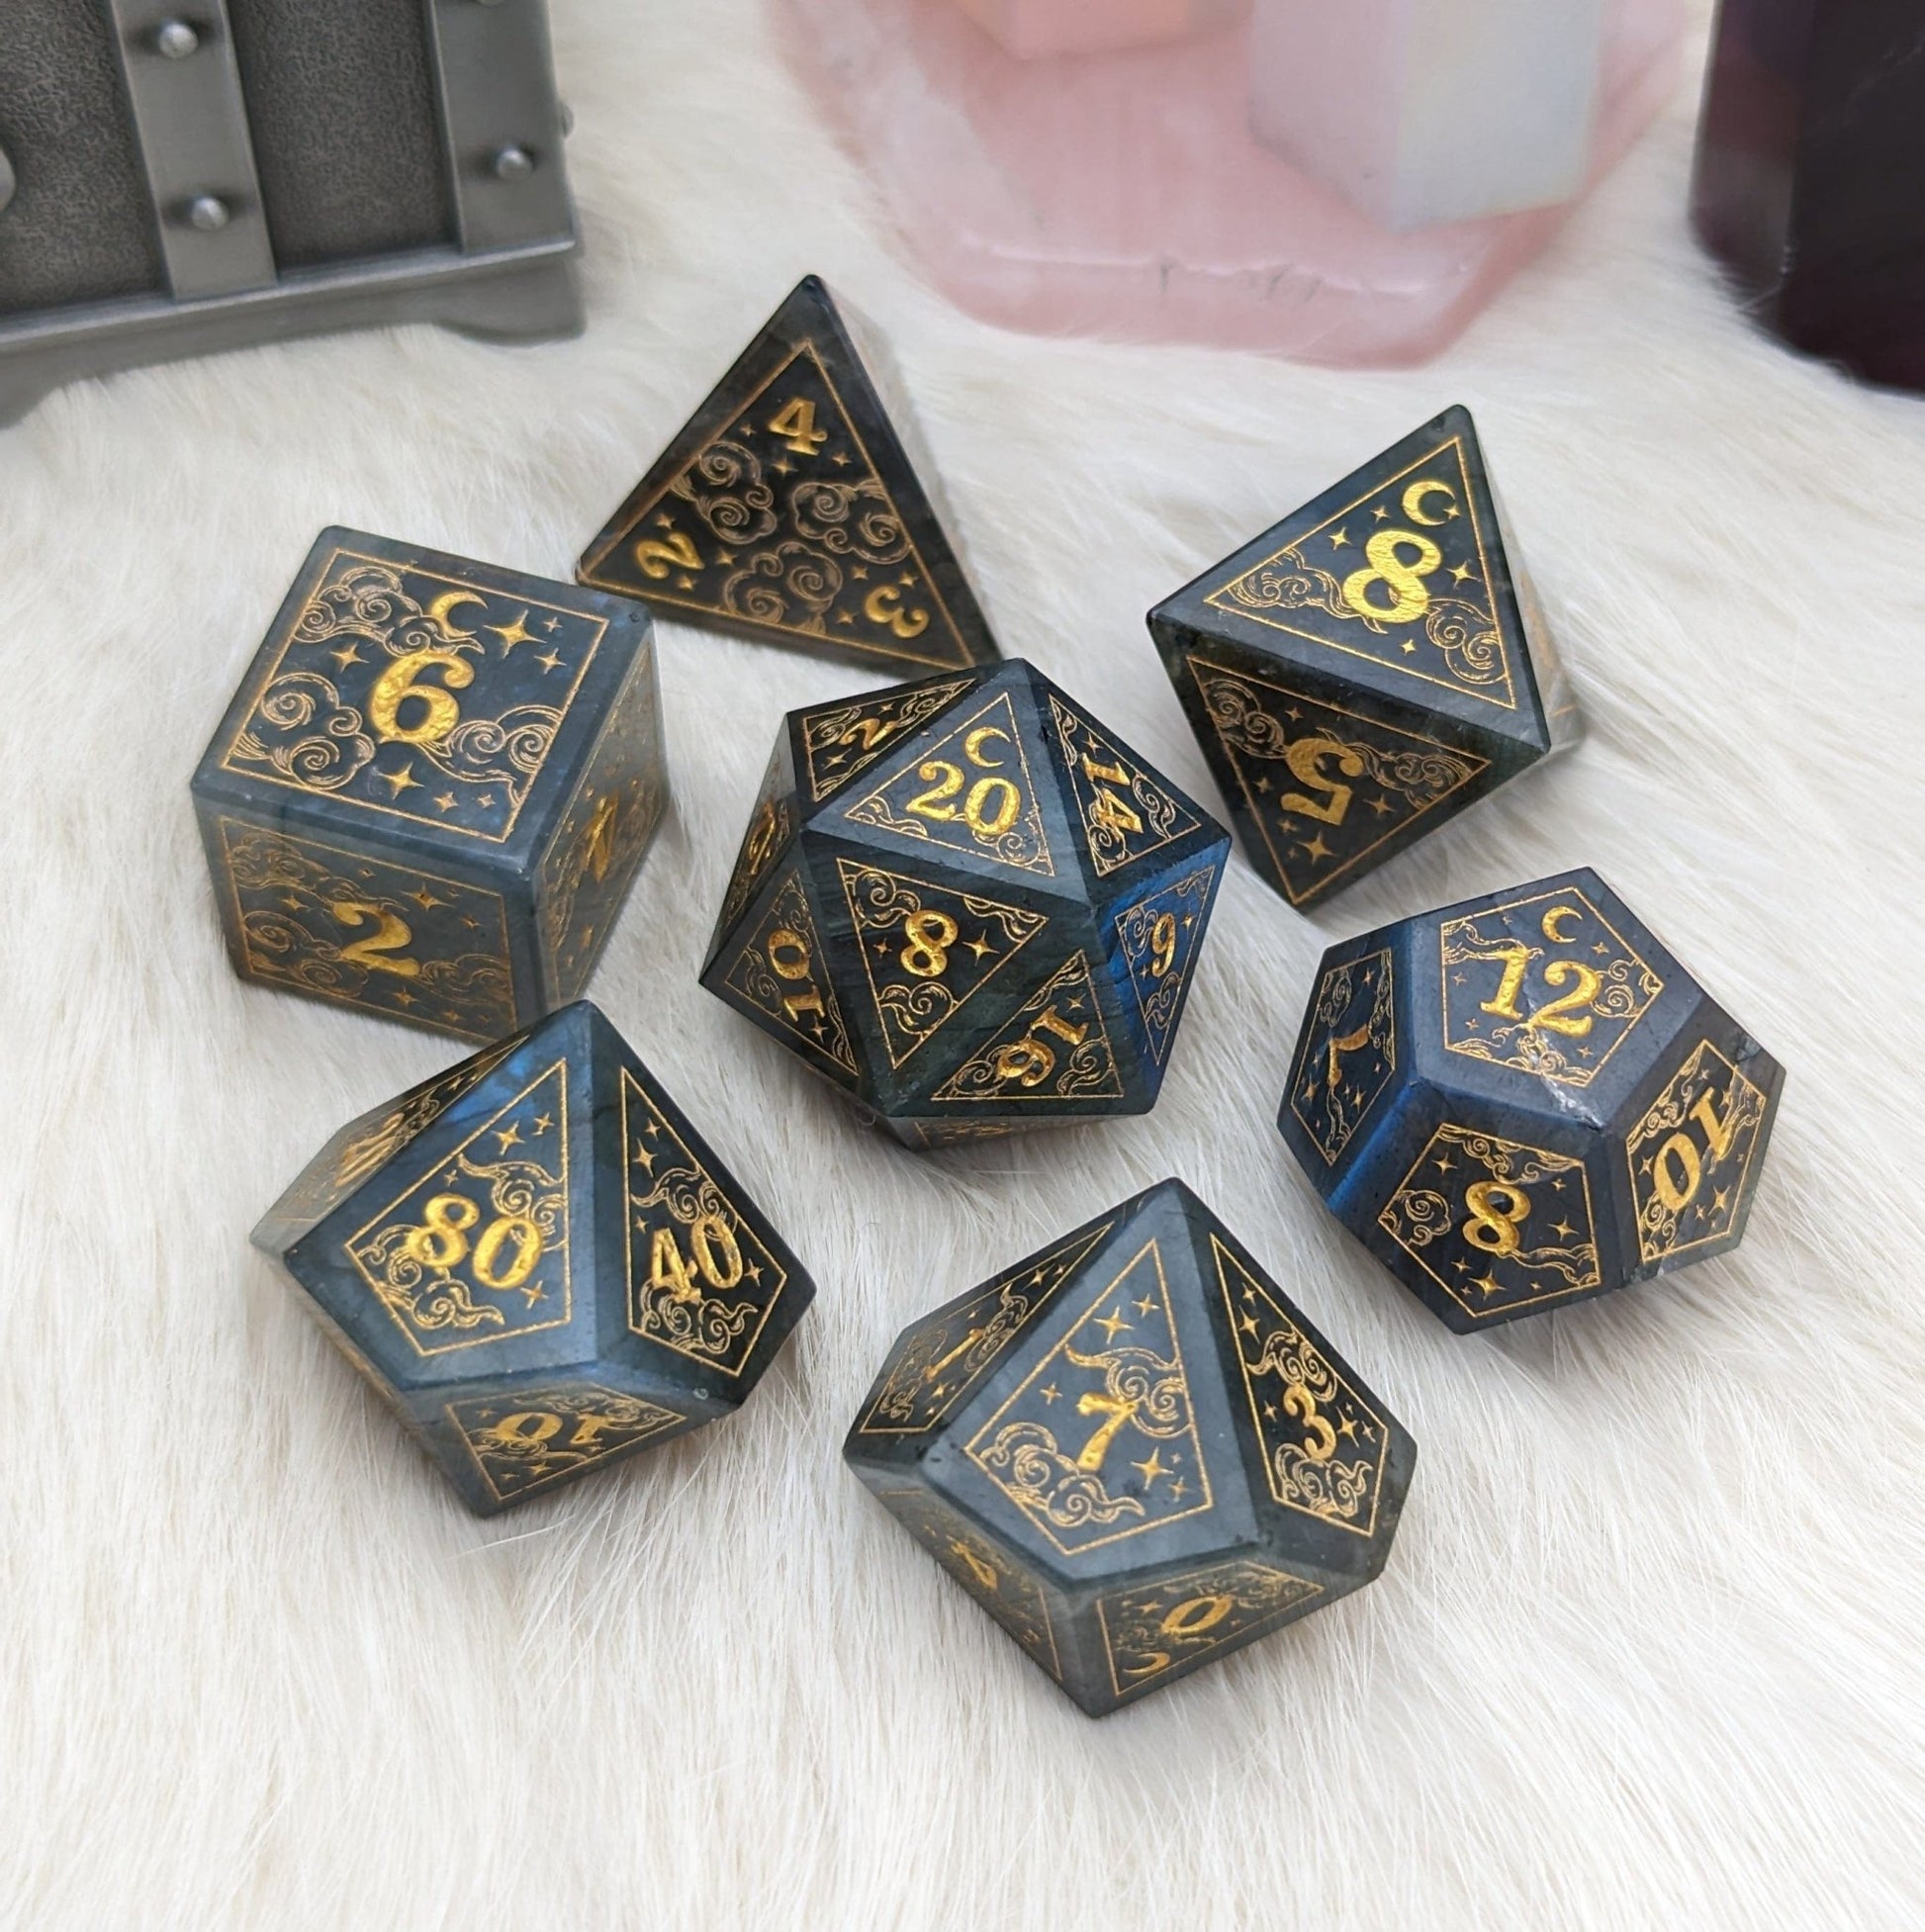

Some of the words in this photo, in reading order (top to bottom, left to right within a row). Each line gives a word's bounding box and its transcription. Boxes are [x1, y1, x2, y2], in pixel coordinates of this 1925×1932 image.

[769, 398, 827, 456] 4
[635, 531, 704, 580] 2
[1342, 530, 1441, 624] 8
[864, 586, 930, 638] 3
[368, 648, 475, 743] 6
[841, 718, 899, 751] 2
[905, 760, 1022, 837] 20
[1081, 753, 1144, 837] 14
[1281, 737, 1364, 826] 5
[329, 900, 421, 976] 2
[768, 929, 824, 1023] 10
[900, 909, 958, 977] 8
[1480, 946, 1602, 1038] 12
[996, 1004, 1089, 1087] 16
[1653, 1086, 1732, 1212] 10
[406, 1192, 546, 1290] 80
[1462, 1180, 1531, 1254] 8
[651, 1214, 743, 1305] 40
[1078, 1392, 1139, 1471] 7
[1283, 1384, 1338, 1461] 3
[1160, 1593, 1234, 1635] 0
